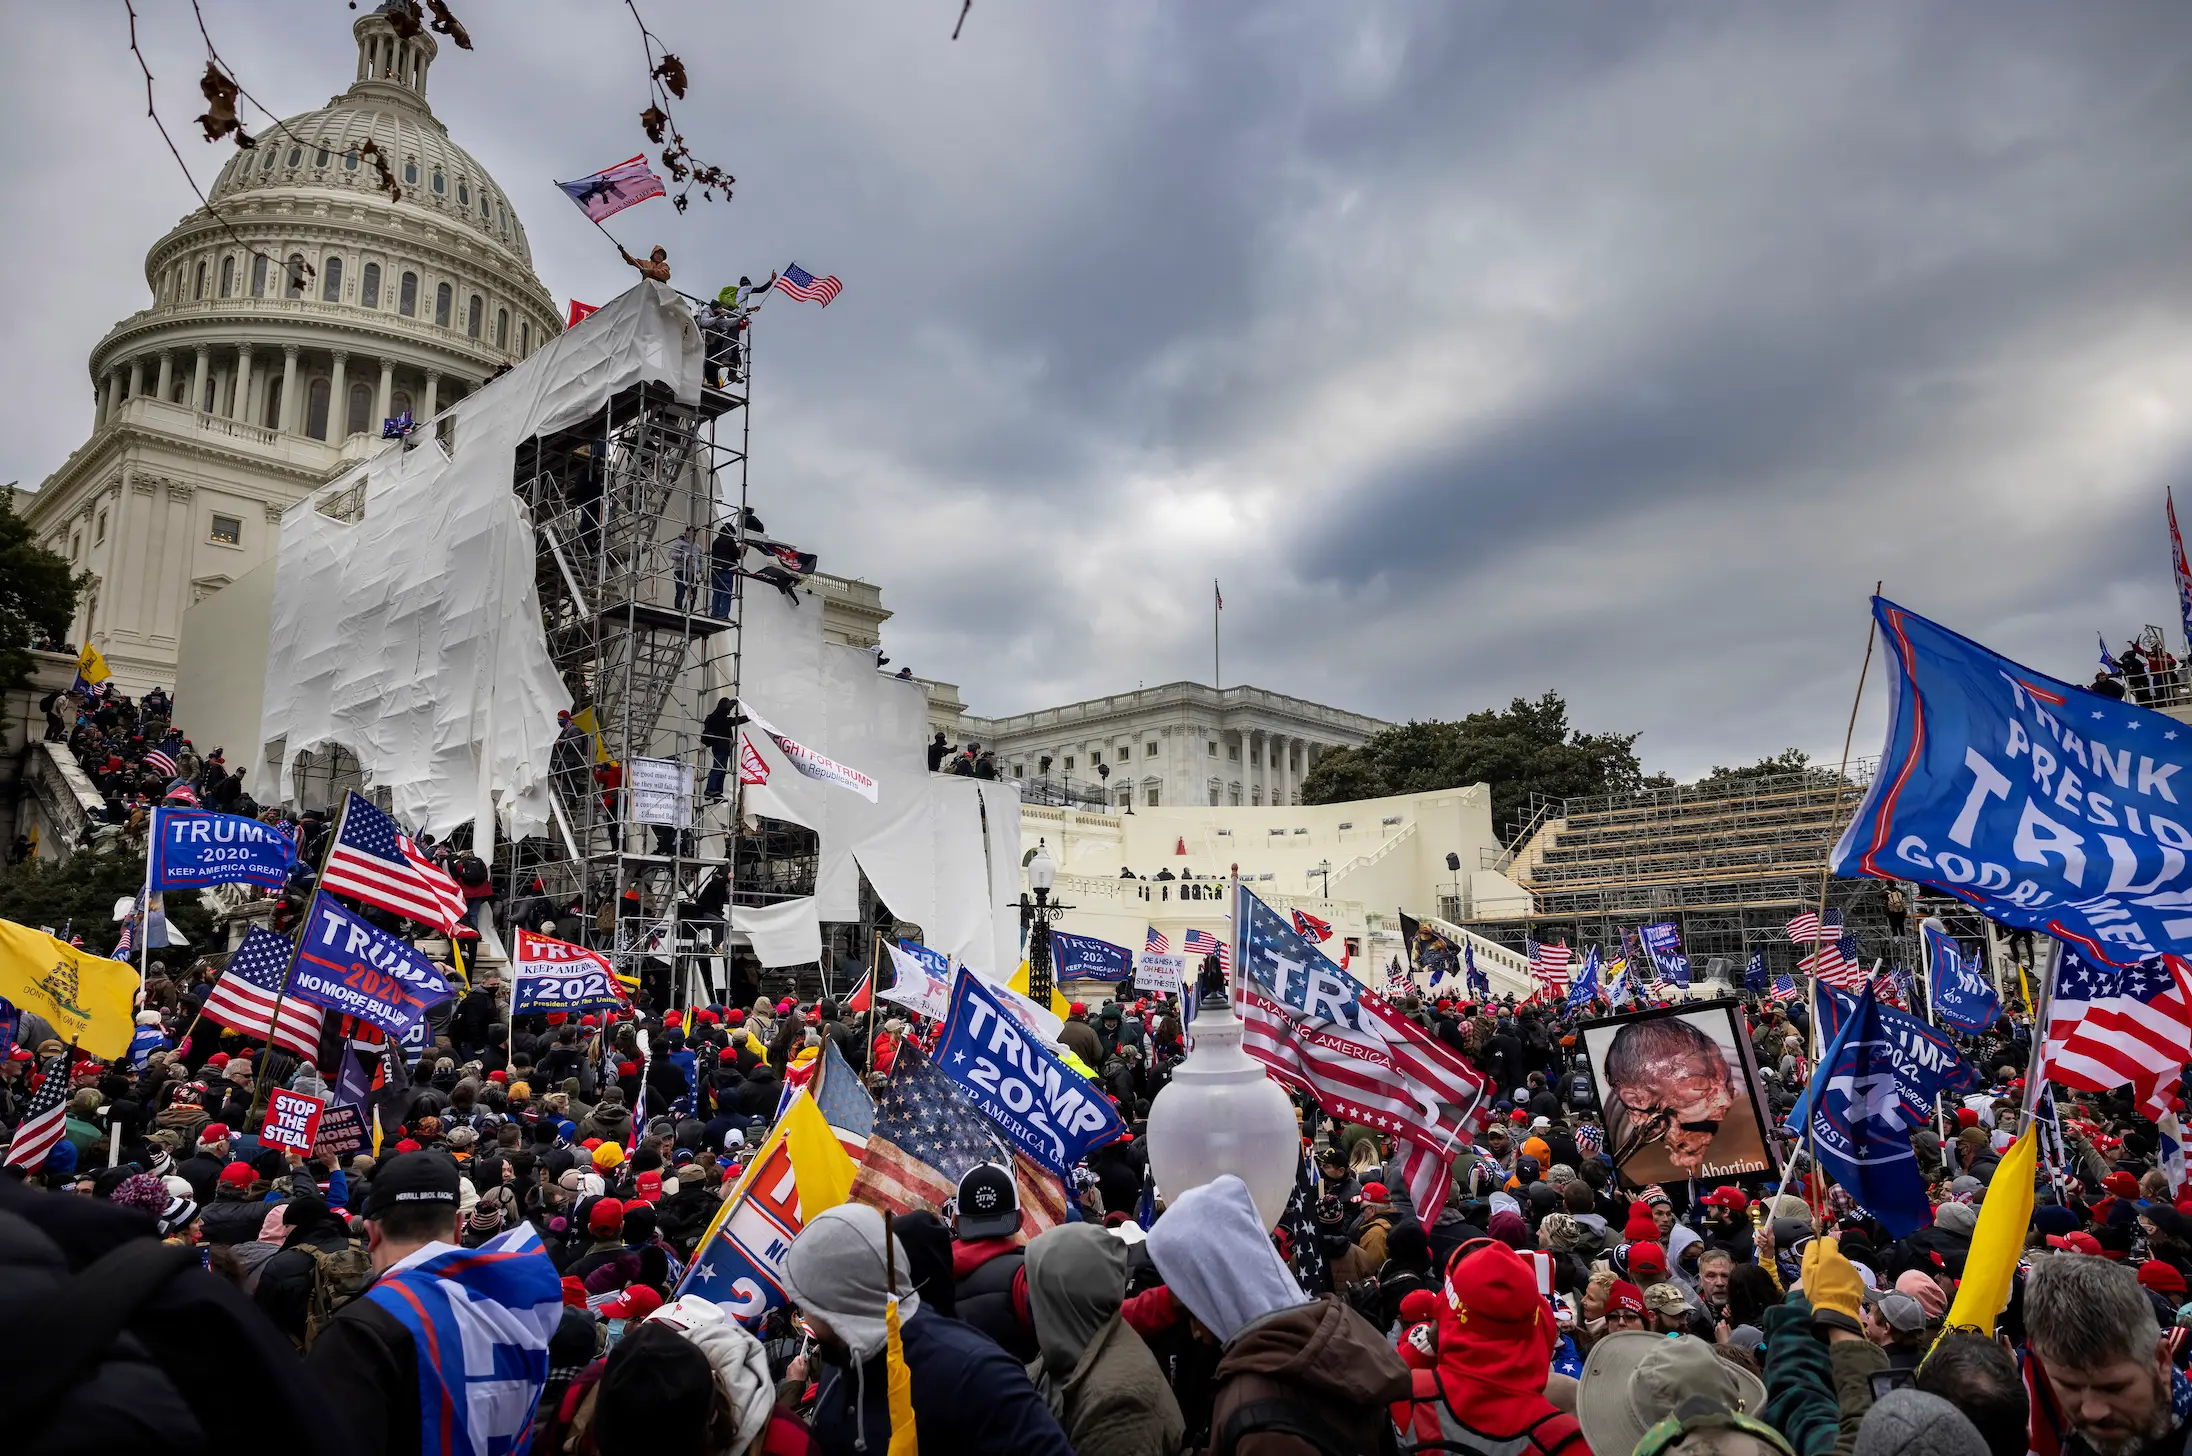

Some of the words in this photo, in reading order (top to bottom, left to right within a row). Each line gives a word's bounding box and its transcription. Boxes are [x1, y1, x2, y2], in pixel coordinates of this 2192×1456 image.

[622, 196, 635, 208] AND
[635, 189, 650, 201] TAKE
[650, 186, 657, 194] IT
[1999, 670, 2183, 804] THANK
[773, 735, 805, 758] FIGHT
[810, 751, 833, 769] FOR
[836, 765, 872, 788] TRUMP
[641, 771, 654, 779] good
[808, 763, 859, 789] Republicans
[641, 781, 652, 789] they
[197, 848, 257, 862] -2020-
[168, 867, 195, 876] KEEP
[199, 864, 246, 876] AMERICA
[249, 864, 283, 877] GREAT!
[525, 965, 553, 974] KEEP
[1141, 957, 1154, 966] JOE
[1159, 958, 1169, 966] HIS
[1154, 966, 1168, 974] HELL
[297, 972, 320, 991] NO
[321, 981, 368, 1008] MORE
[1136, 978, 1153, 987] STOP
[1154, 979, 1166, 987] THE
[23, 986, 45, 1000] DONT
[62, 1015, 75, 1027] ON
[75, 1021, 88, 1032] ME
[1257, 997, 1312, 1039] MAKING
[1315, 1034, 1392, 1070] AMERICA
[967, 991, 1107, 1137] TRUMP
[275, 1095, 317, 1117] STOP
[277, 1111, 307, 1130] THE
[978, 1100, 1046, 1157] AMERICA
[263, 1124, 310, 1150] STEAL
[315, 1125, 362, 1143] MORE
[1701, 1158, 1764, 1178] Abortion
[980, 1193, 994, 1201] 1776
[1620, 1296, 1642, 1309] Trump
